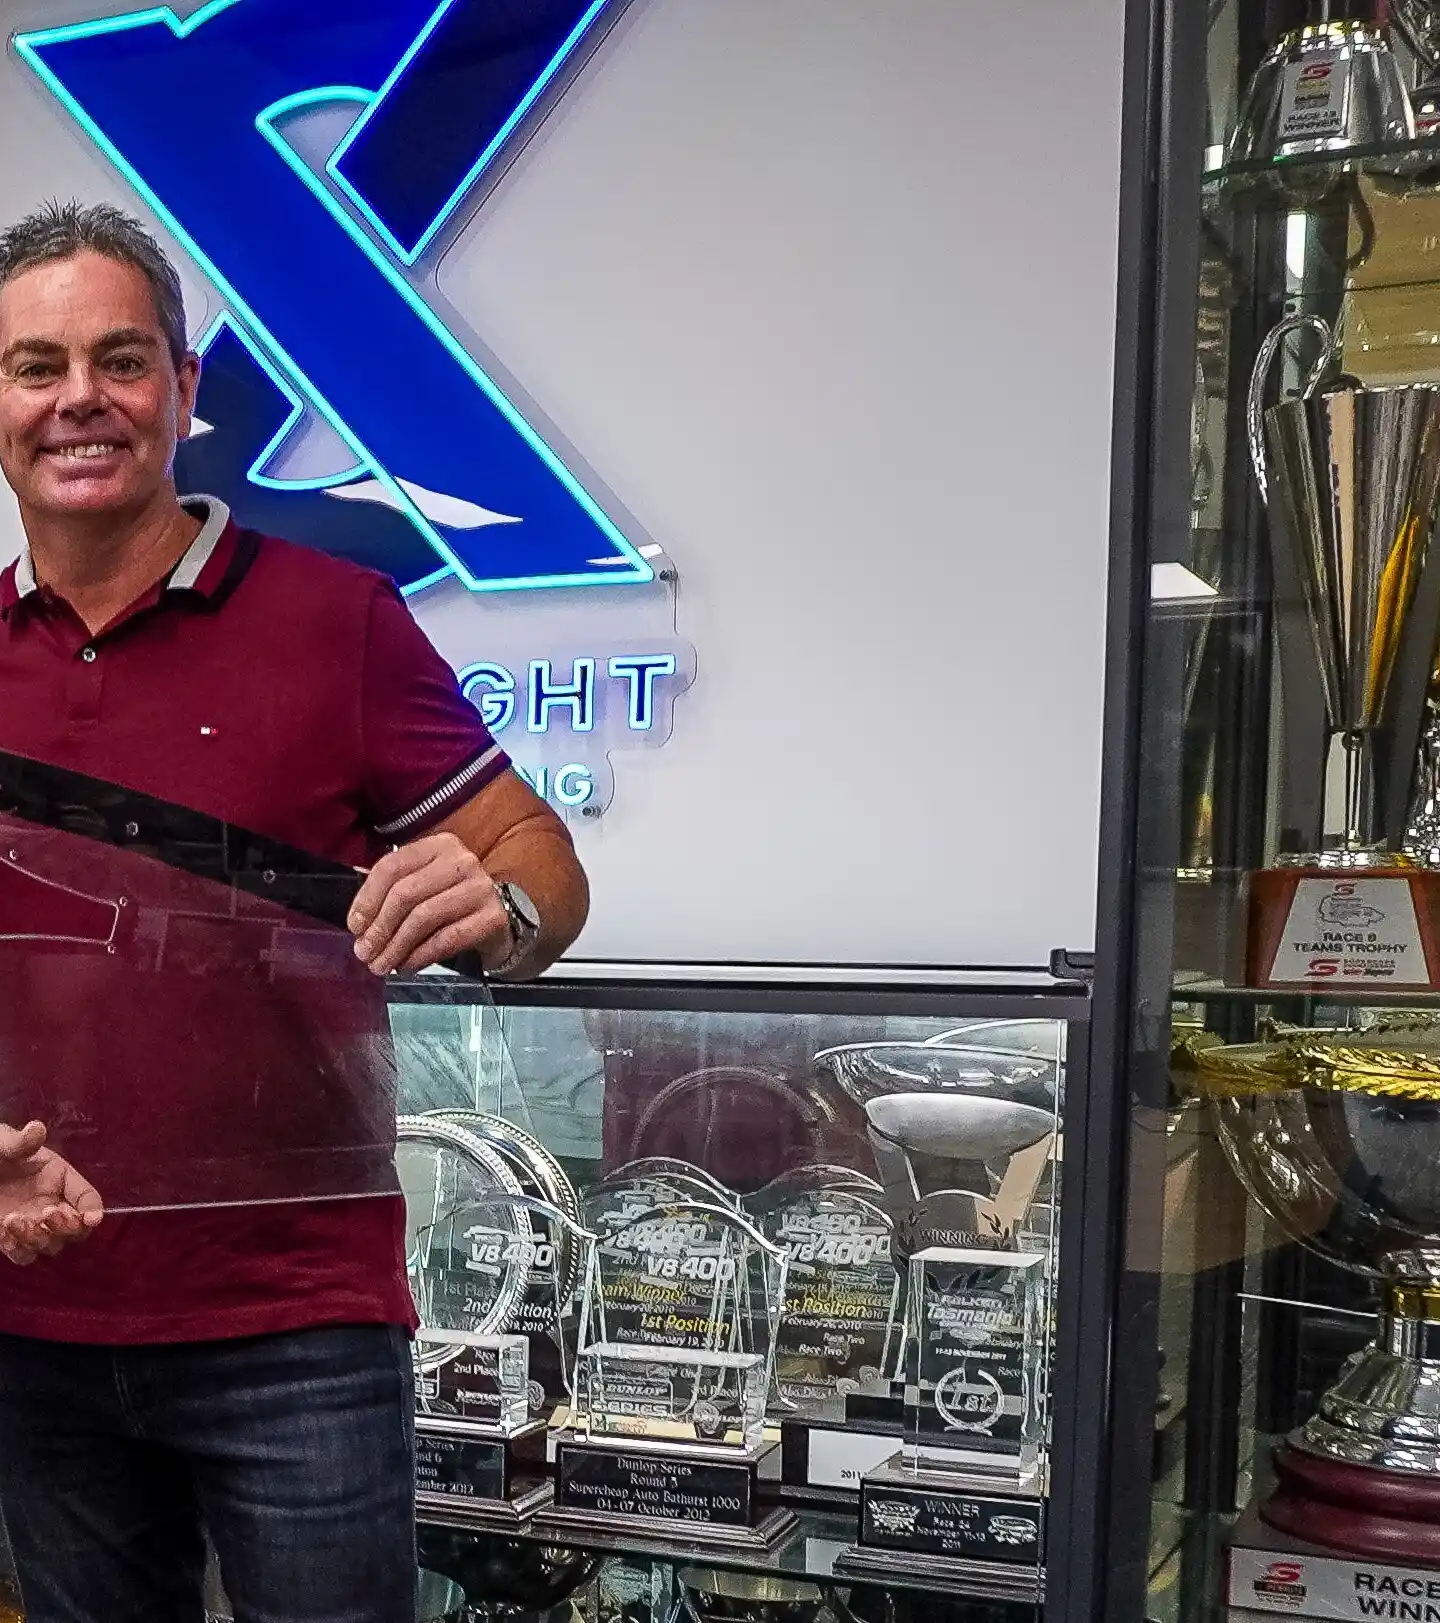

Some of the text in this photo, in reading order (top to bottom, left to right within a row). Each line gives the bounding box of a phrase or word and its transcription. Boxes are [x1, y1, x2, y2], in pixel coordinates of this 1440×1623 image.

[1293, 942, 1408, 954] TEAMS TROPHY
[647, 1255, 679, 1278] V8
[462, 1296, 494, 1314] 2nd
[641, 1312, 730, 1335] 1st Position
[660, 1461, 693, 1476] Series
[630, 1472, 666, 1488] Round
[569, 1480, 741, 1510] Supercheap Auto Bathurst 1000
[637, 1500, 680, 1518] October
[683, 1508, 711, 1522] 2012
[924, 1500, 980, 1518] WINNER
[1355, 1573, 1440, 1600] RACE
